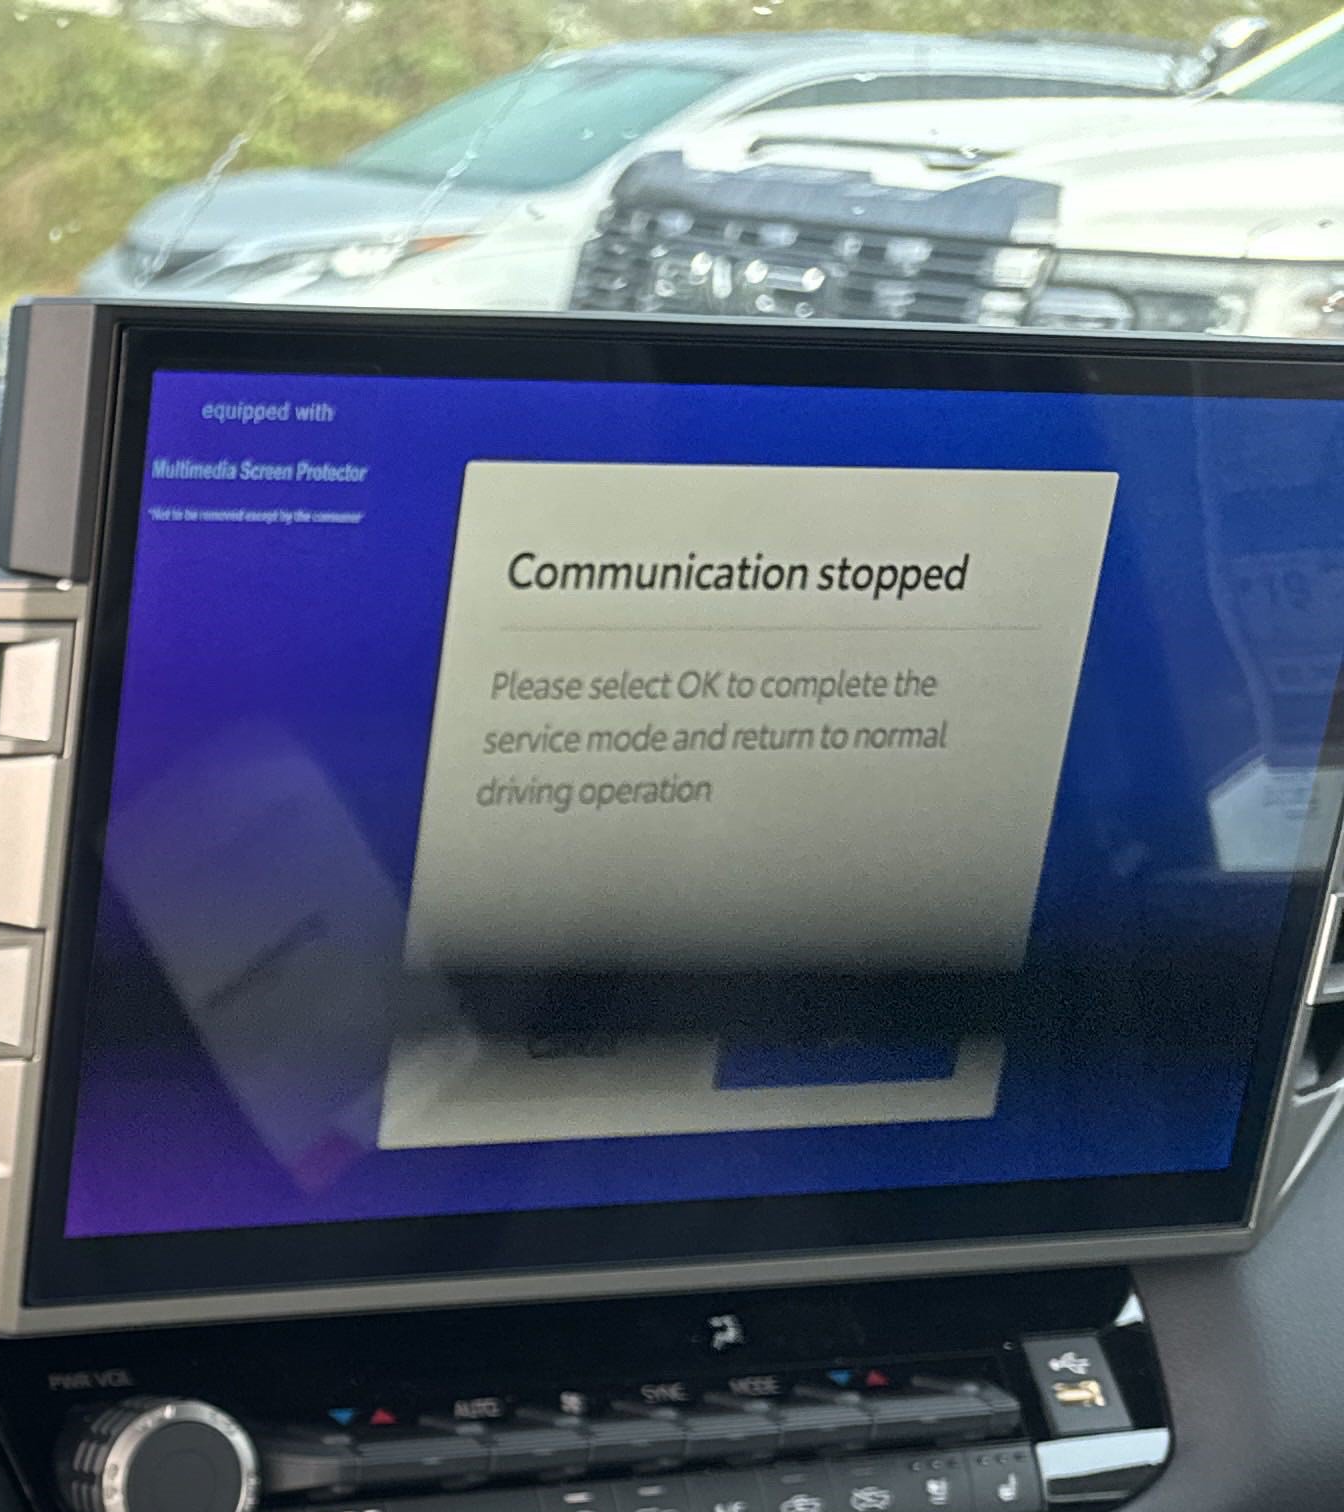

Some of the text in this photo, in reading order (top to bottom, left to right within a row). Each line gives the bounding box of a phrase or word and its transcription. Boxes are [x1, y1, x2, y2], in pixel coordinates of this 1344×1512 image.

[202, 402, 336, 424] equipped with
[151, 460, 367, 482] Multimedia Screen Protector
[508, 552, 970, 600] Communication stopped
[491, 669, 938, 704] Please select OK to complete the
[483, 720, 948, 754] service mode and return to normal
[476, 772, 712, 813] driving operation
